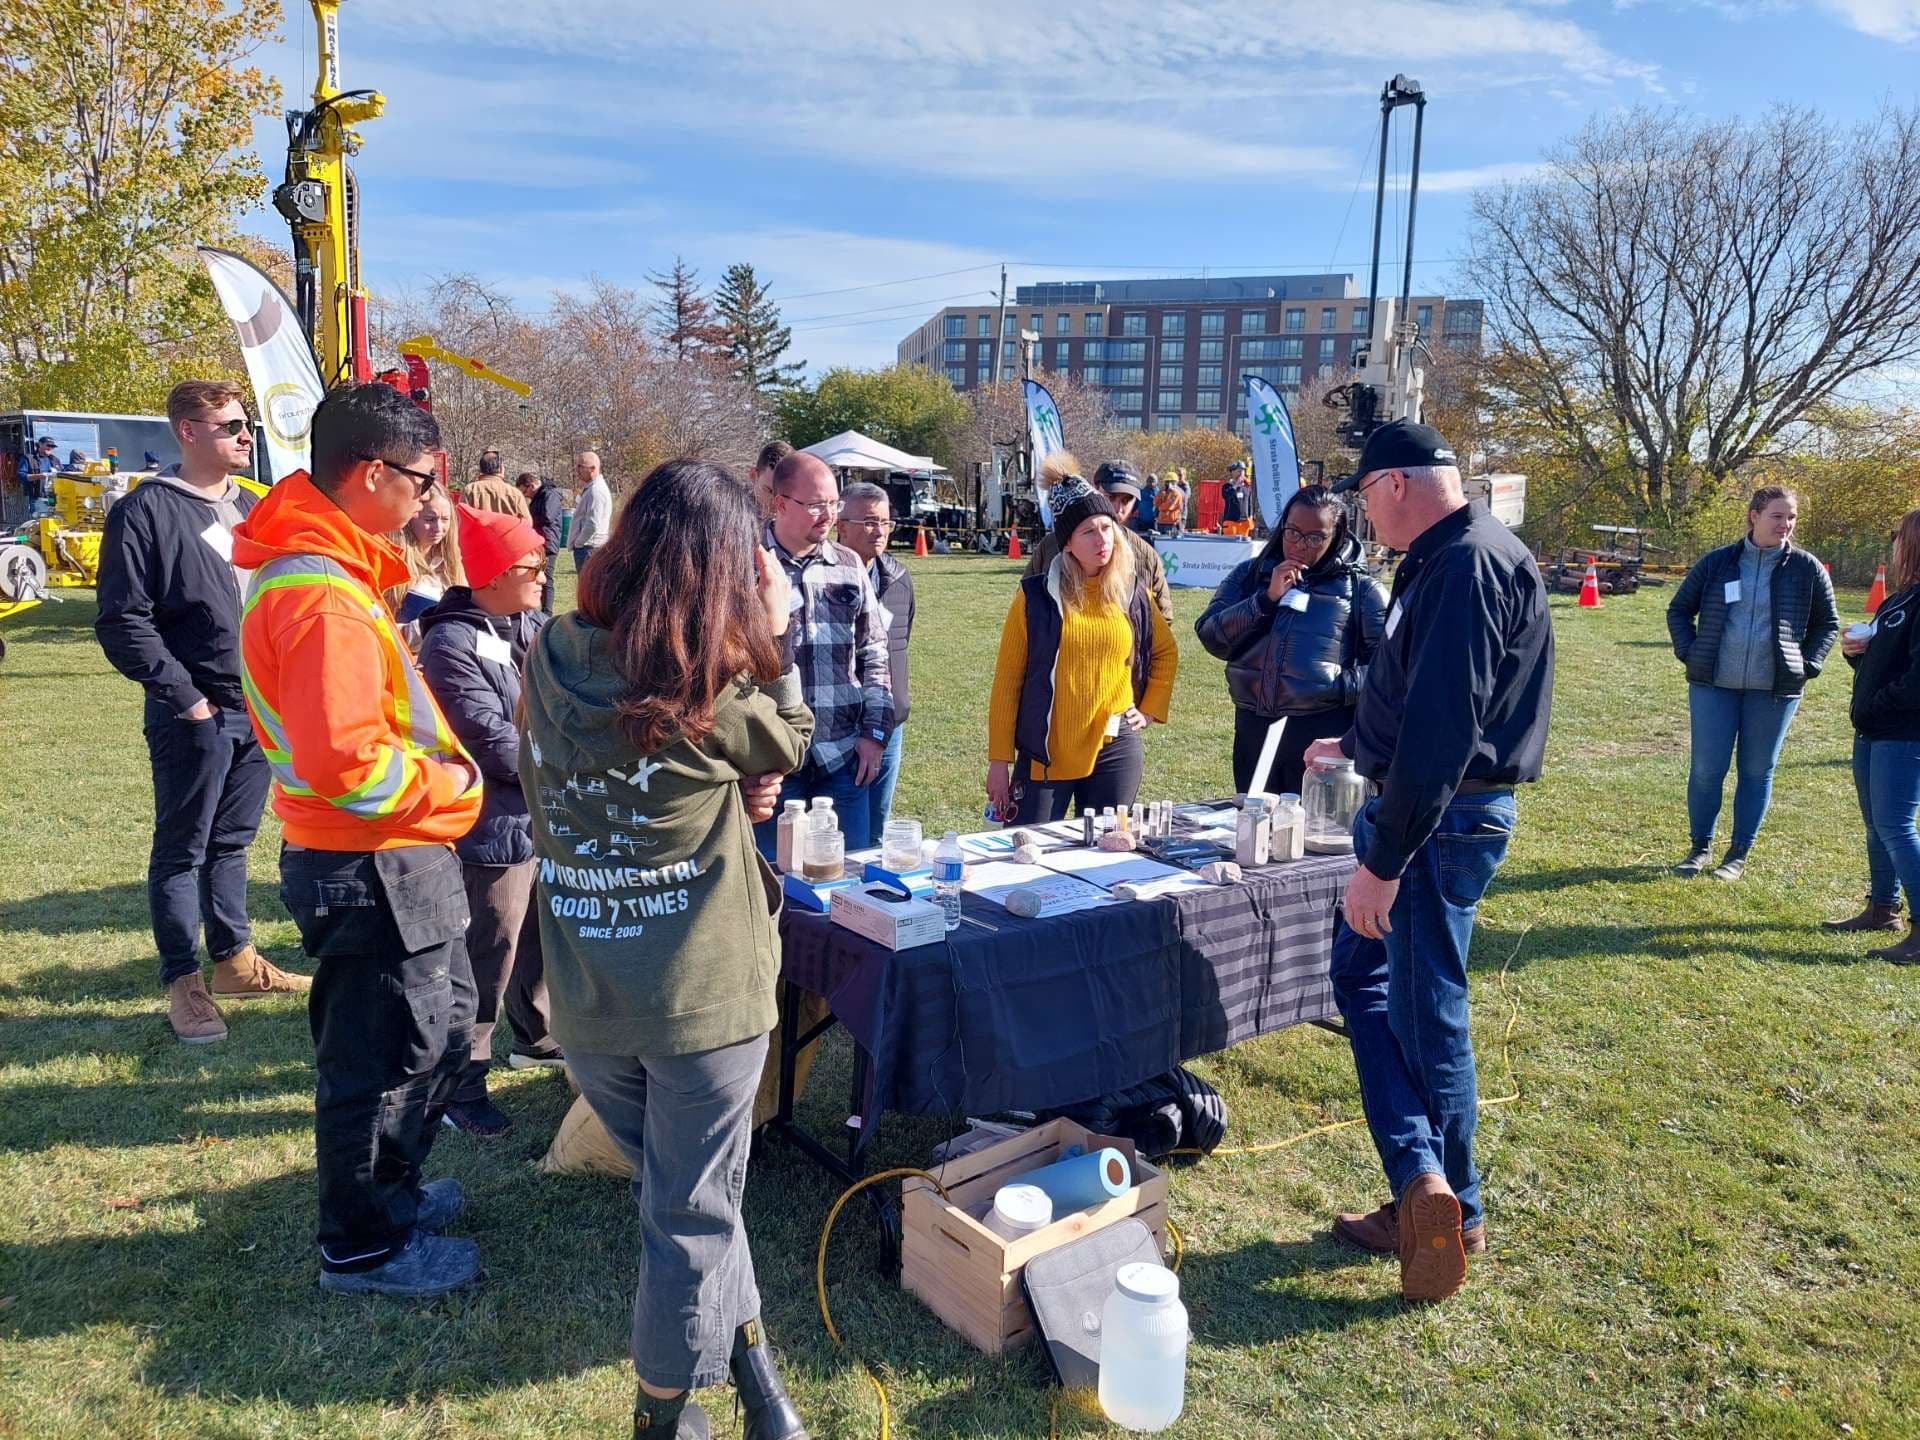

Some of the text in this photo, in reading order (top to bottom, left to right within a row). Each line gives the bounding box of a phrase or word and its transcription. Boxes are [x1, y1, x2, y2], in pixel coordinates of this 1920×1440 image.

[1270, 438, 1278, 462] Strata
[1272, 464, 1280, 492] Drilling
[1200, 561, 1221, 571] Drilling
[536, 857, 706, 892] NVIRONMENTAL
[551, 895, 601, 920] GOOD
[624, 888, 689, 918] TIMES
[579, 925, 643, 939] SINCE 2003
